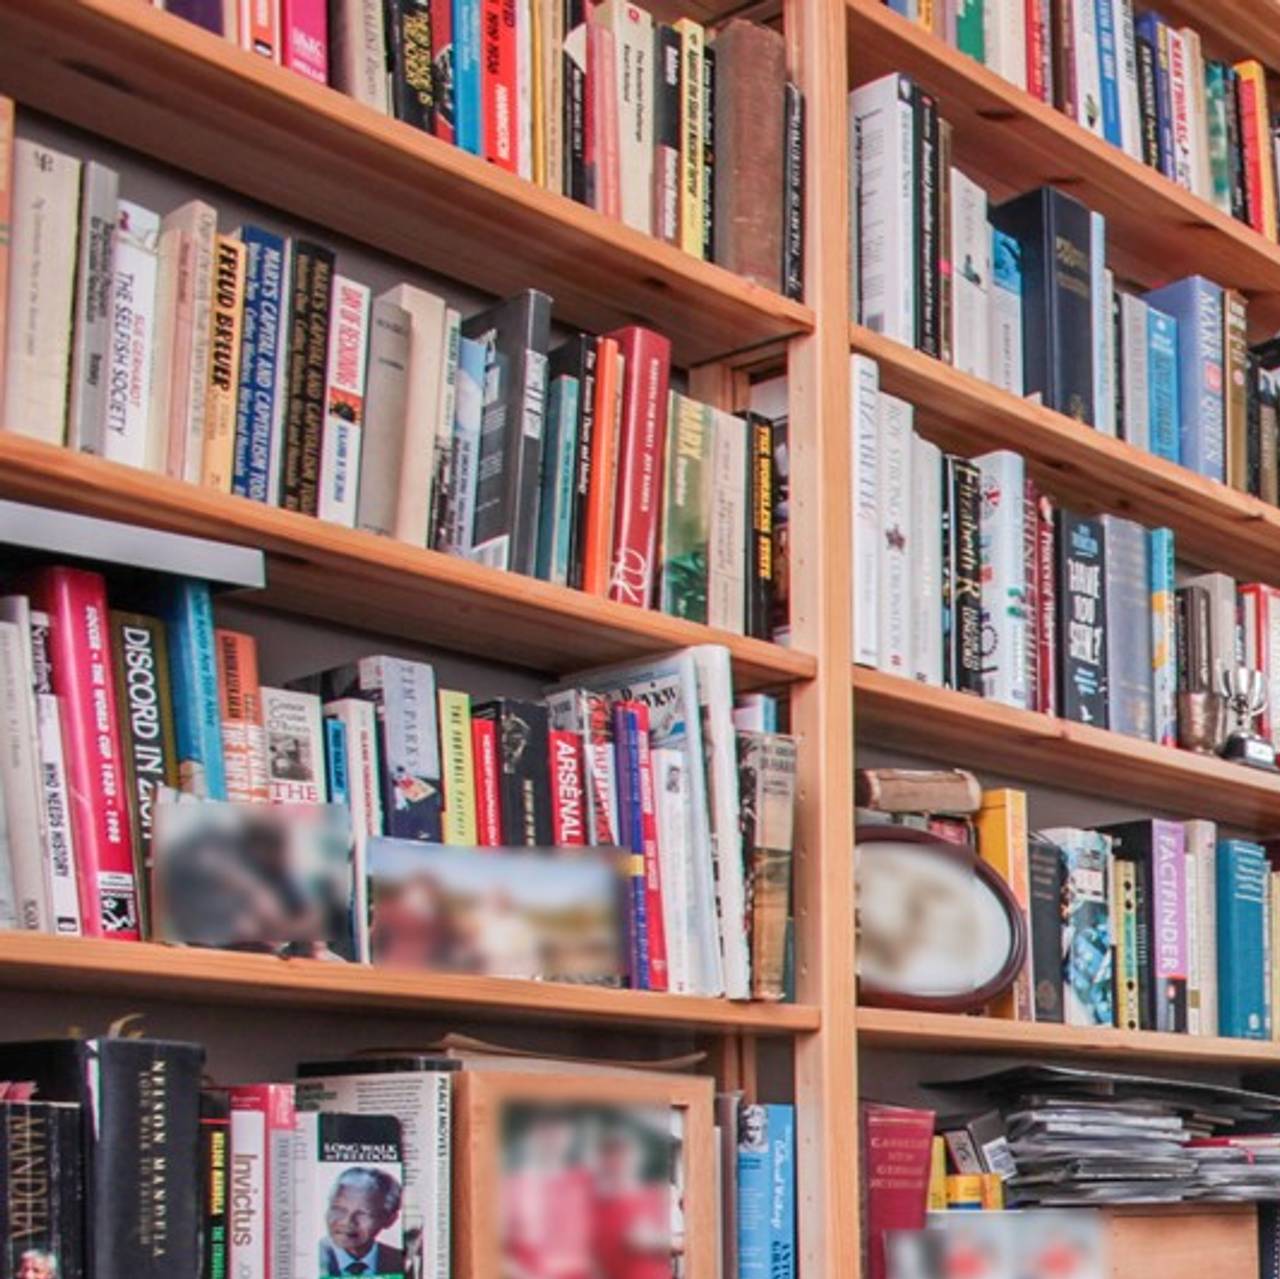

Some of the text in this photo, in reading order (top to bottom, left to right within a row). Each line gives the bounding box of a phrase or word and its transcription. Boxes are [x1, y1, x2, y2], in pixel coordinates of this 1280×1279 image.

[108, 271, 134, 436] THE SELFISH SOCIETY
[211, 243, 238, 392] FREUD BREUER
[252, 247, 282, 470] MARX'S CAPITAL AND CAPITALISM
[303, 259, 329, 480] MARX'S CAPITAL AND CAPITALISM
[1199, 290, 1221, 465] MARR QUEEN
[758, 425, 772, 581] THE WORKLESS STATE
[955, 464, 982, 600] Elizabeth R
[86, 606, 100, 649] SOCCER
[400, 665, 416, 706] TIM
[92, 689, 107, 731] WORLD
[96, 735, 111, 759] CUP
[122, 626, 158, 771] DISCORD IN
[44, 762, 69, 878] WHO NEEDS HISTORY
[555, 739, 582, 841] ARSÈNAL
[1156, 831, 1179, 973] FACTFINDER
[211, 1132, 224, 1168] NELSON
[324, 1144, 397, 1154] LONG WALK
[437, 1077, 448, 1113] PEACE
[437, 1115, 448, 1158] MOVES
[7, 1115, 50, 1238] MANDELA
[151, 1060, 167, 1258] NELSON MANDELA
[211, 1170, 225, 1216] MANDELA
[233, 1153, 258, 1247] Invictus
